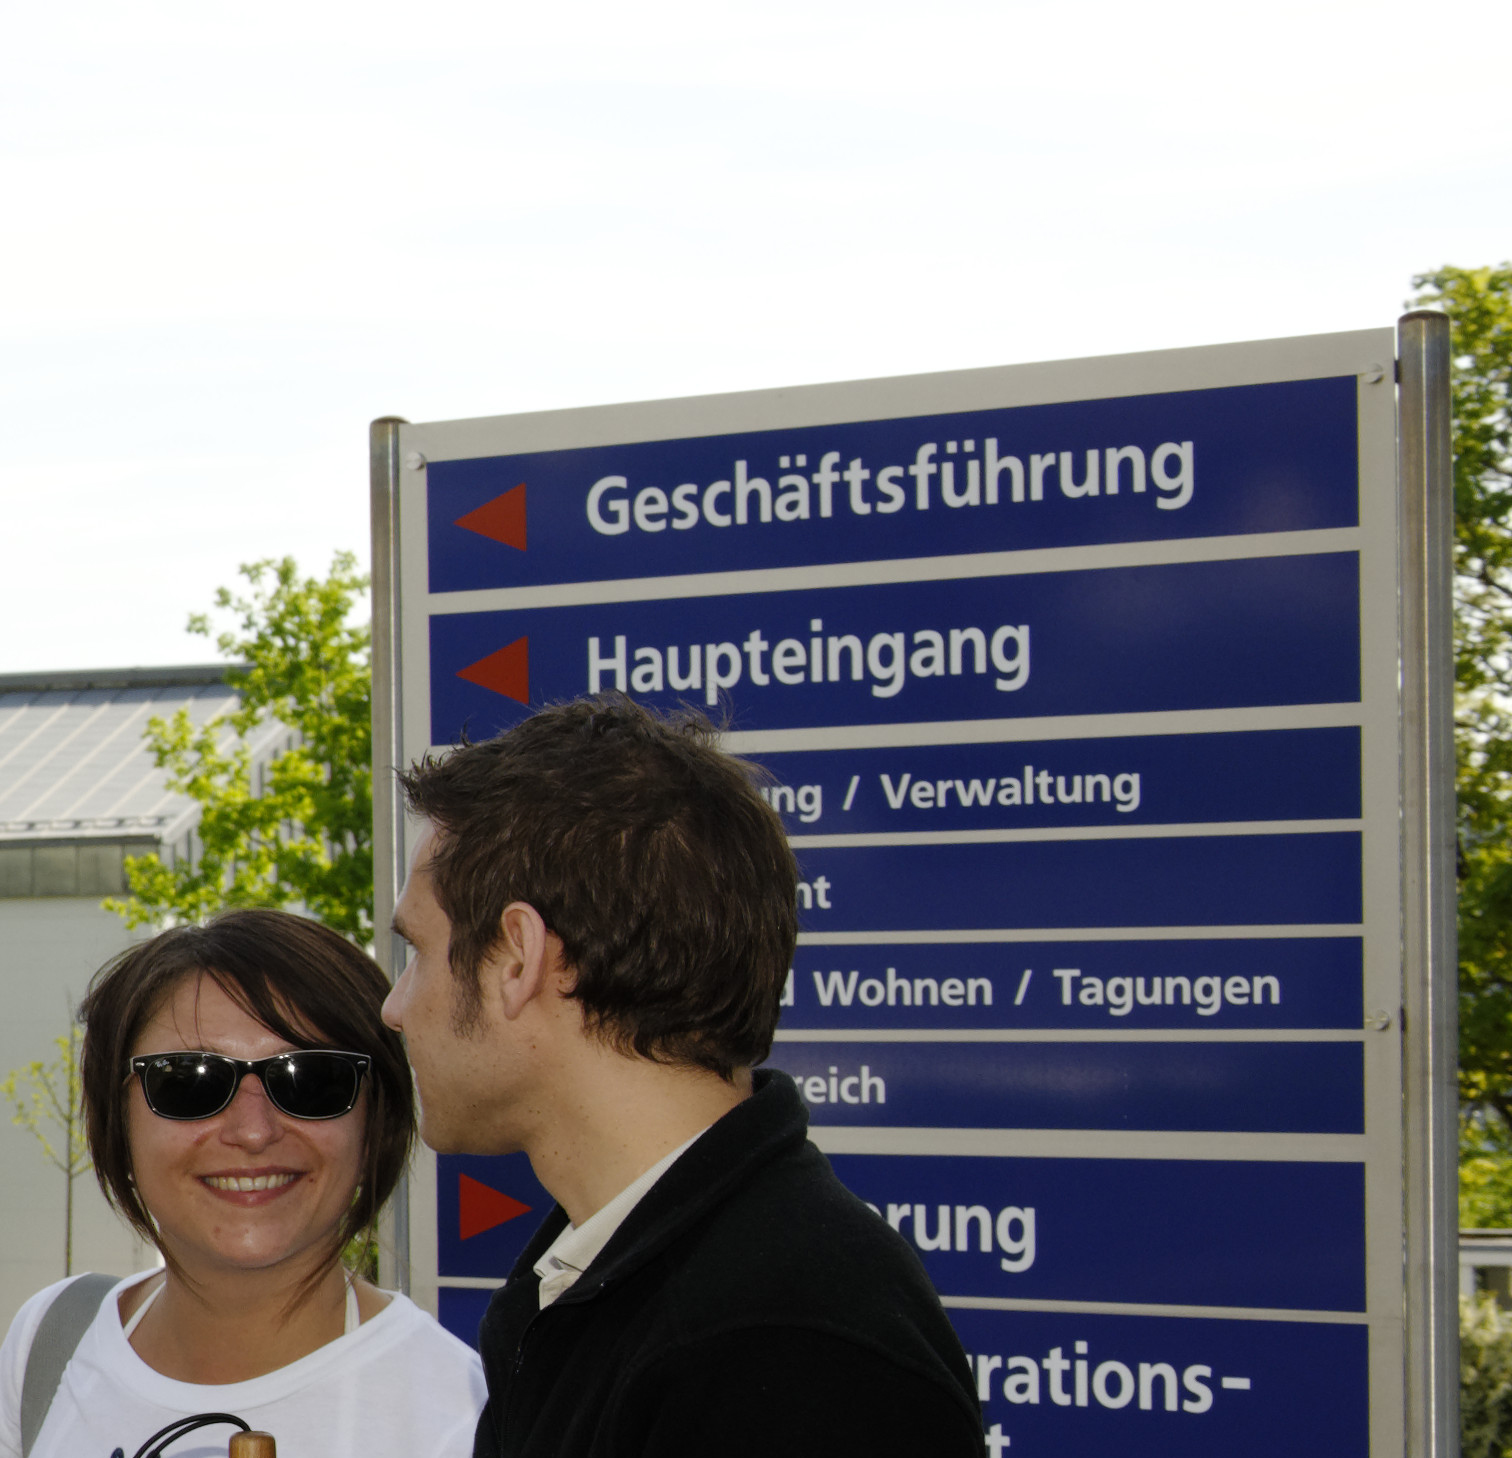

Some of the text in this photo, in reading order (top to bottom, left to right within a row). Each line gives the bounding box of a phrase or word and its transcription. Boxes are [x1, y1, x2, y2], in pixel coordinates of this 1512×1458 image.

[586, 437, 1195, 535] Geschäftsführung
[587, 618, 1031, 705] Haupteingang
[880, 765, 1143, 813] Verwaltung
[795, 874, 832, 910] nt
[811, 968, 994, 1007] Wohnen
[1052, 968, 1282, 1016] Tagungen
[792, 1064, 887, 1105] reich
[865, 1202, 1037, 1273] rung
[965, 1340, 1252, 1414] rations-
